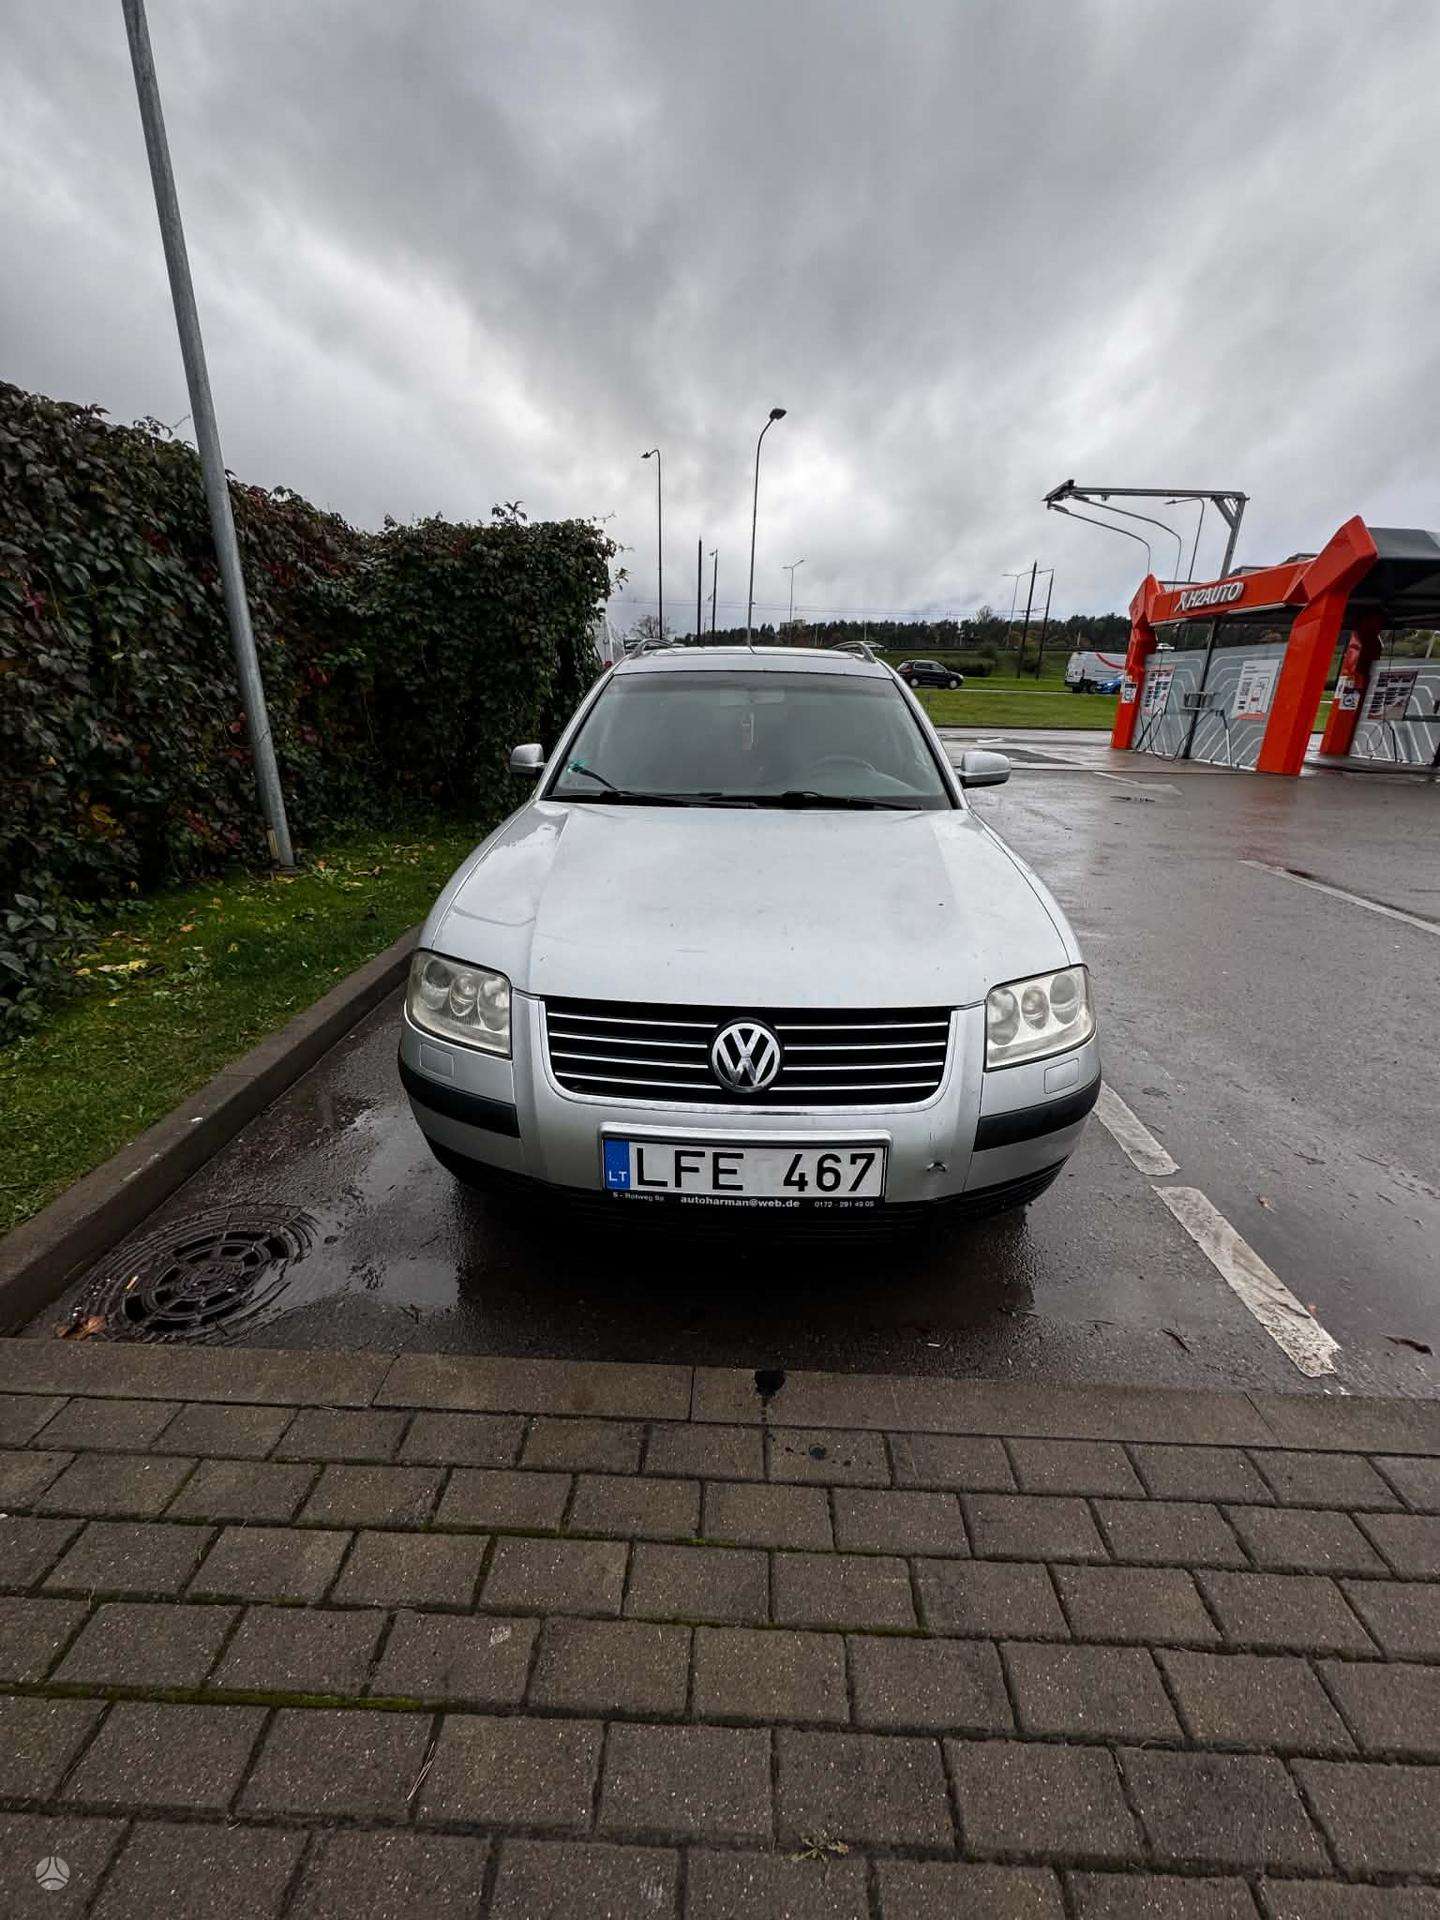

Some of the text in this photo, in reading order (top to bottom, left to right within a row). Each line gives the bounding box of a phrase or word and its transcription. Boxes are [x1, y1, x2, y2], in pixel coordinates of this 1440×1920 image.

[636, 1147, 877, 1193] LFE 467
[608, 1171, 627, 1183] LT
[680, 1196, 801, 1208] autoharman@web.de
